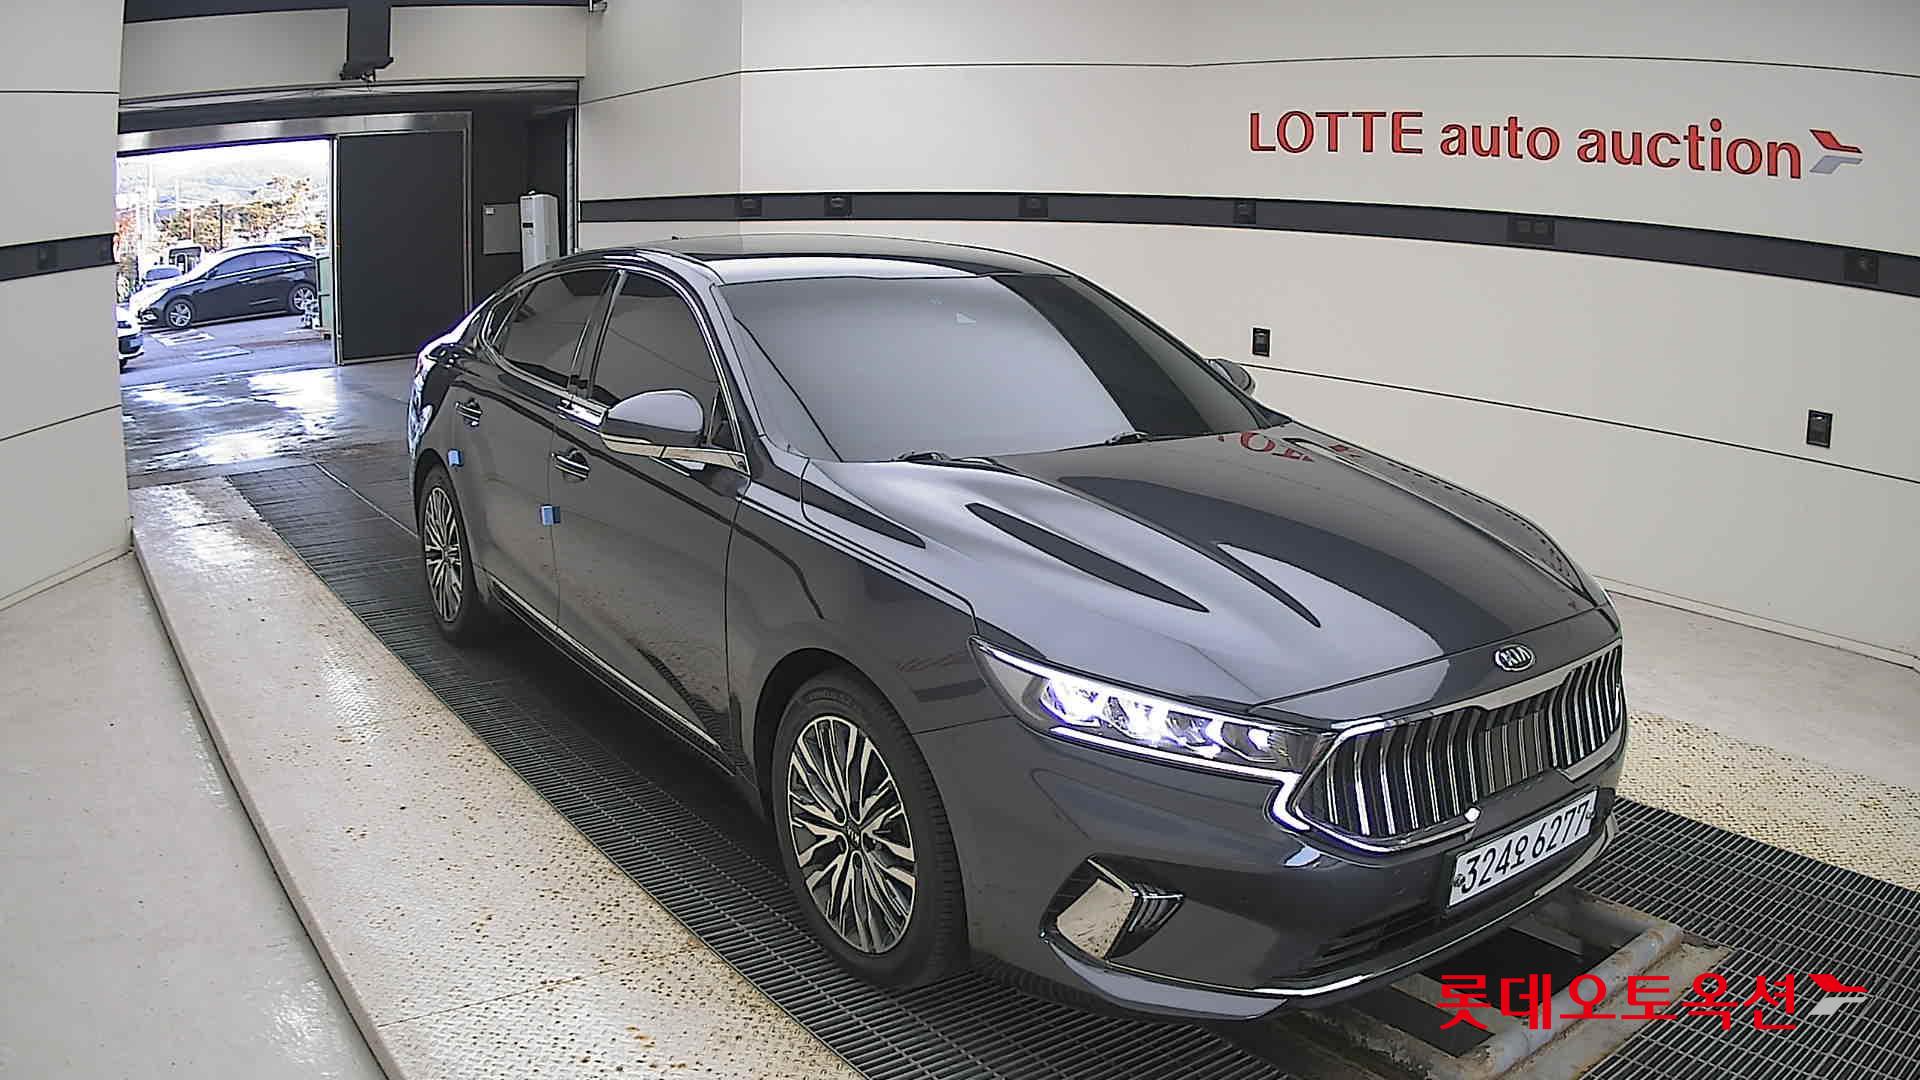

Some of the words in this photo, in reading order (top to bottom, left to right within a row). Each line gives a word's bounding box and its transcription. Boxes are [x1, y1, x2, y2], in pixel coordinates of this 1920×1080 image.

[1249, 111, 1424, 154] LOTTE
[1440, 117, 1561, 160] auto
[1576, 118, 1802, 179] auction
[1499, 646, 1532, 667] KIA
